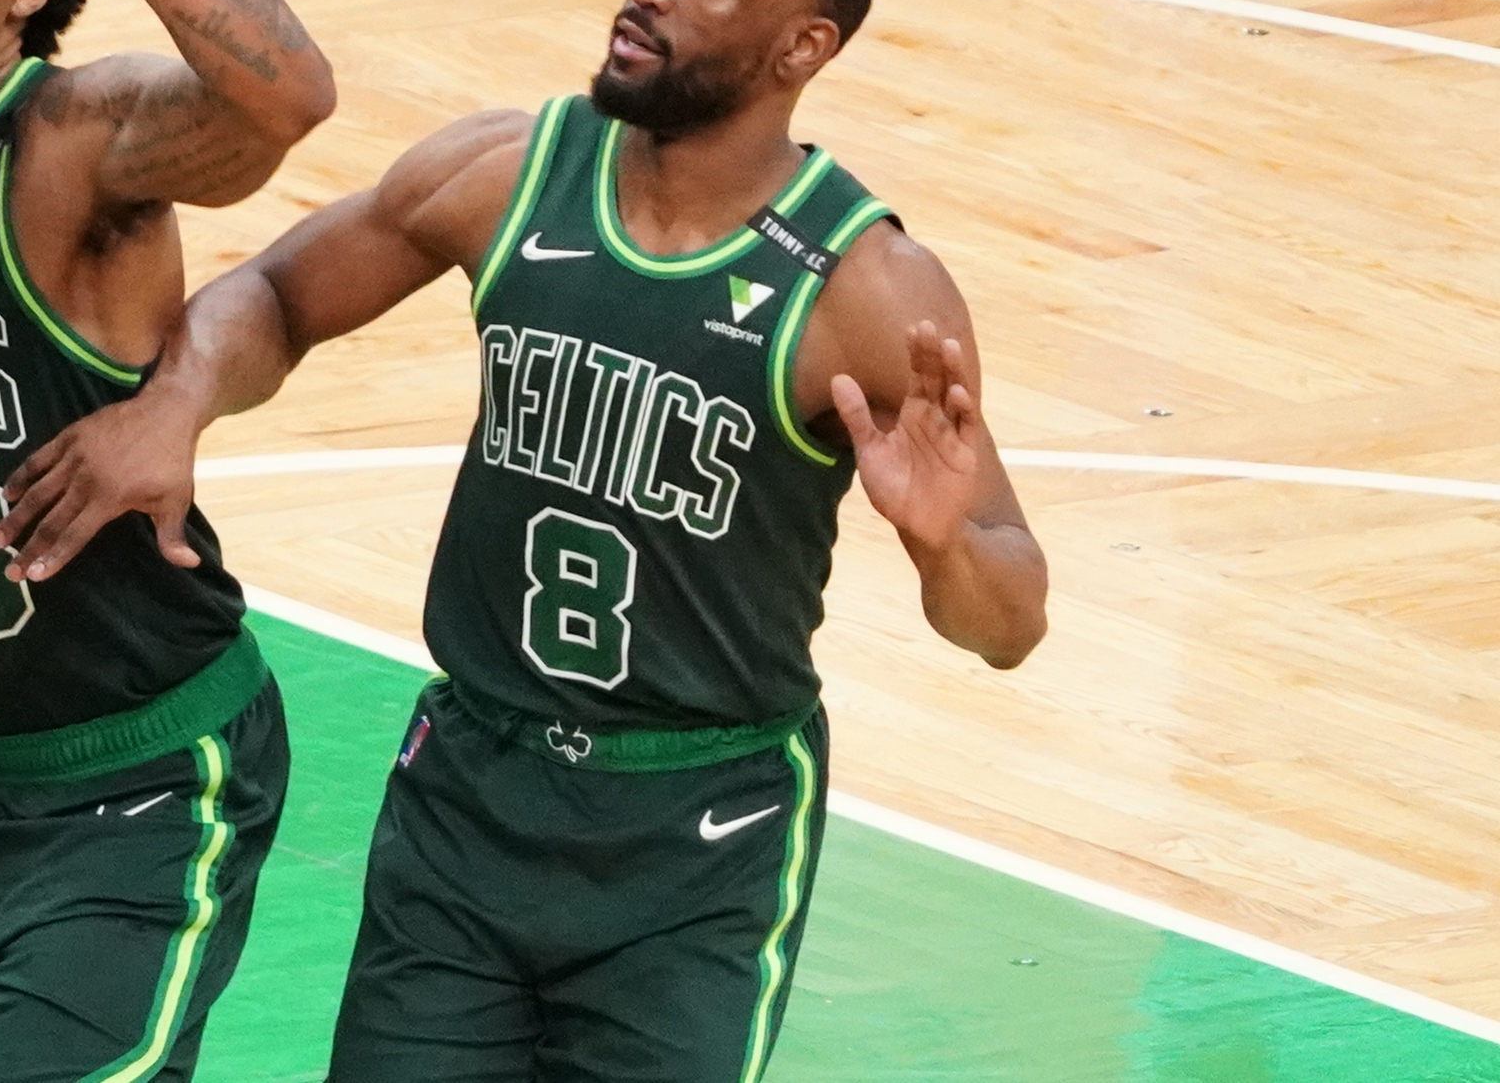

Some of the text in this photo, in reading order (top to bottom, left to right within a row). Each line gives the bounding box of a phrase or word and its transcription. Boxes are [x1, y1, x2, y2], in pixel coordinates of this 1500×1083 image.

[760, 216, 804, 255] TOMMY
[703, 319, 764, 347] vistaprint
[481, 324, 756, 540] CELTICS
[522, 506, 637, 691] 8
